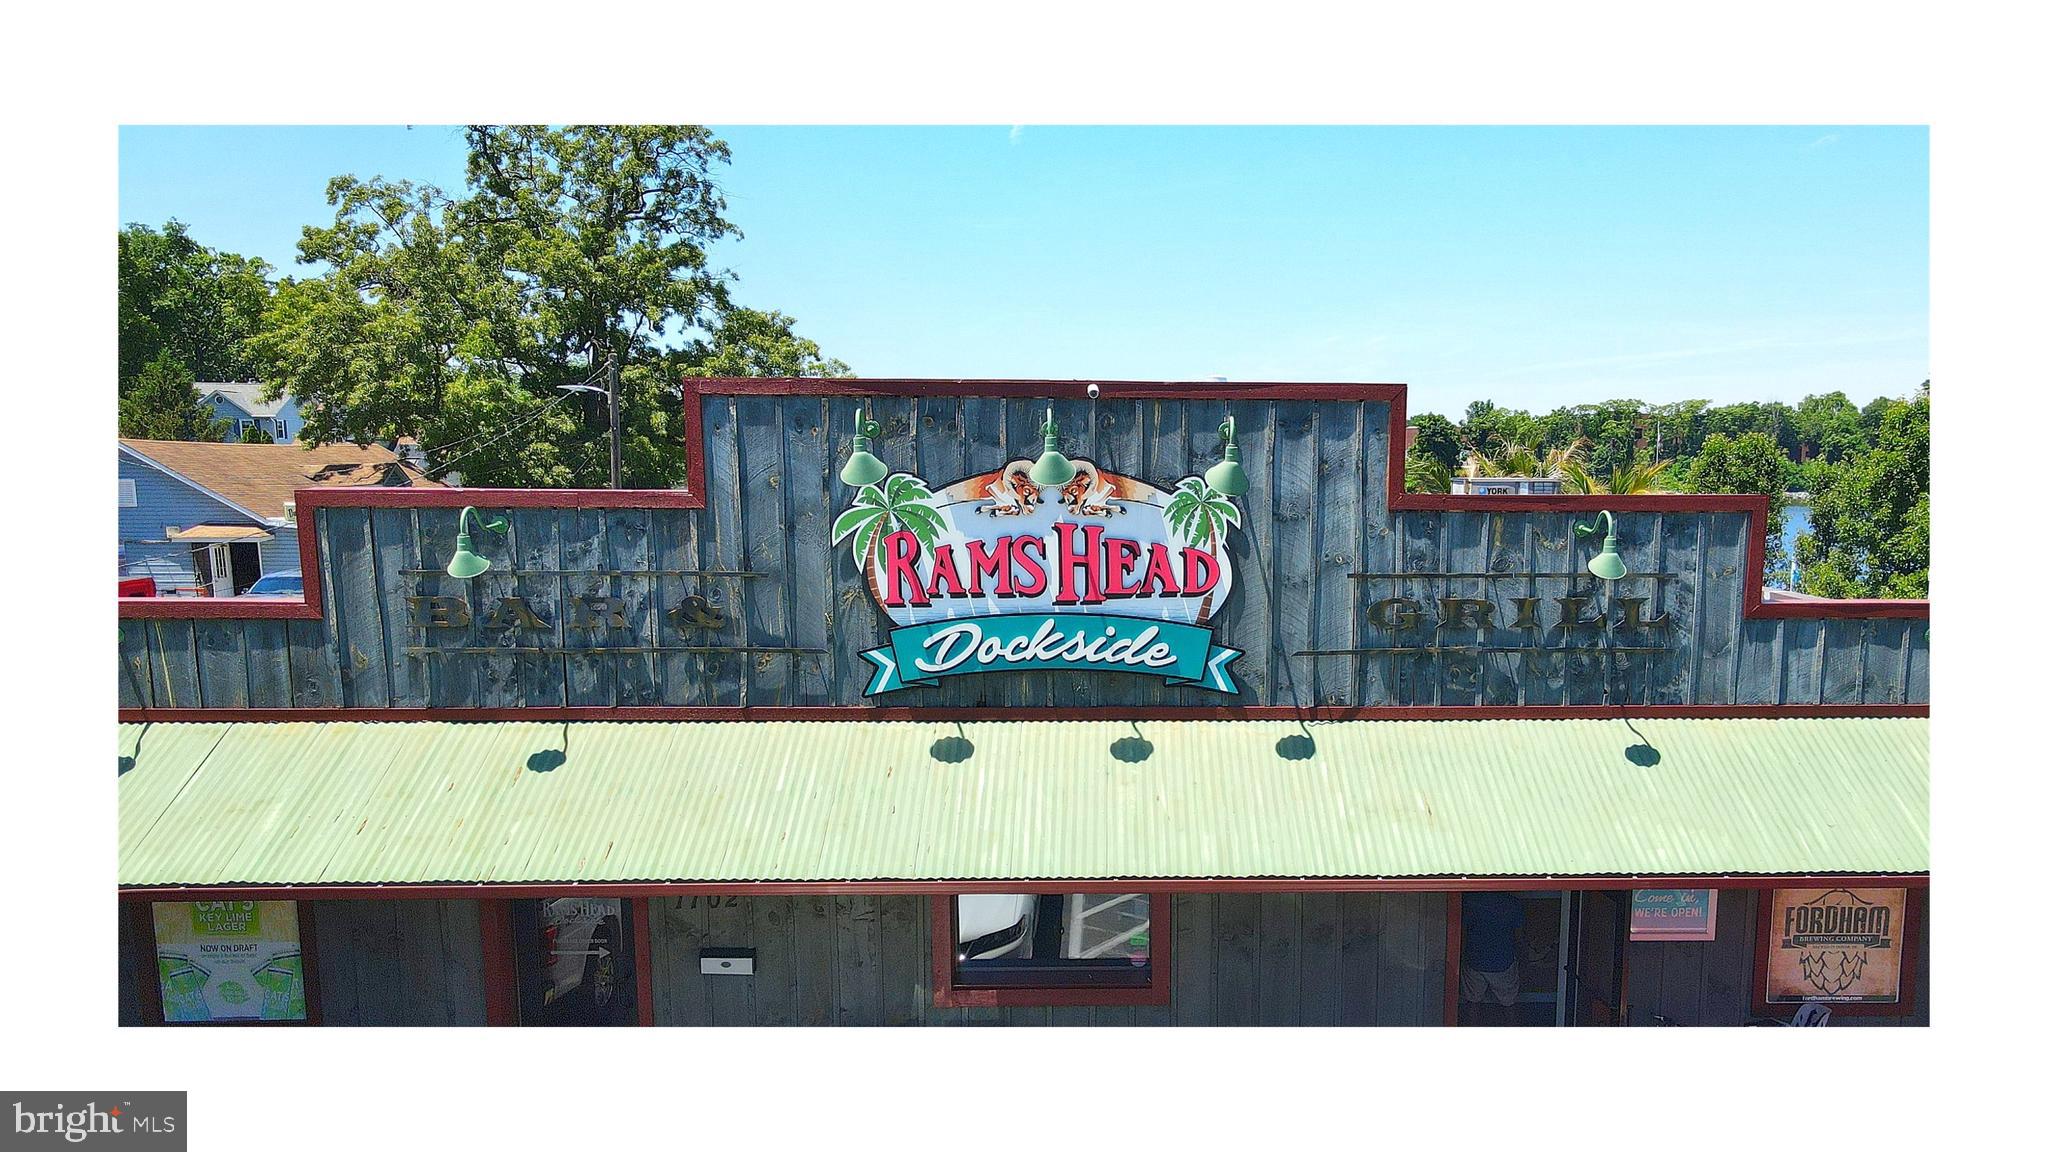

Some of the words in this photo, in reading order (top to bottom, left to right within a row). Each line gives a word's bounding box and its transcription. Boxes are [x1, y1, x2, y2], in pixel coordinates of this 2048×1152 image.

[1487, 487, 1508, 495] YORK
[883, 531, 1048, 607] RAMS
[1053, 522, 1221, 606] HEAD
[407, 596, 632, 629] BAR
[667, 595, 727, 630] &
[1366, 597, 1670, 630] GRILL
[914, 618, 1177, 672] Dockside
[1634, 889, 1673, 903] Come
[199, 912, 222, 922] KEY
[226, 911, 252, 922] LIME
[1634, 907, 1667, 918] WE'RE
[1671, 906, 1702, 918] OPEN!
[207, 922, 246, 931] LAGER
[1784, 905, 1890, 936] FORDHAM
[1799, 935, 1834, 943] BREWING
[1836, 935, 1873, 943] COMPANY
[200, 944, 219, 952] NOW
[221, 944, 232, 952] ON
[233, 943, 258, 952] DRAFT
